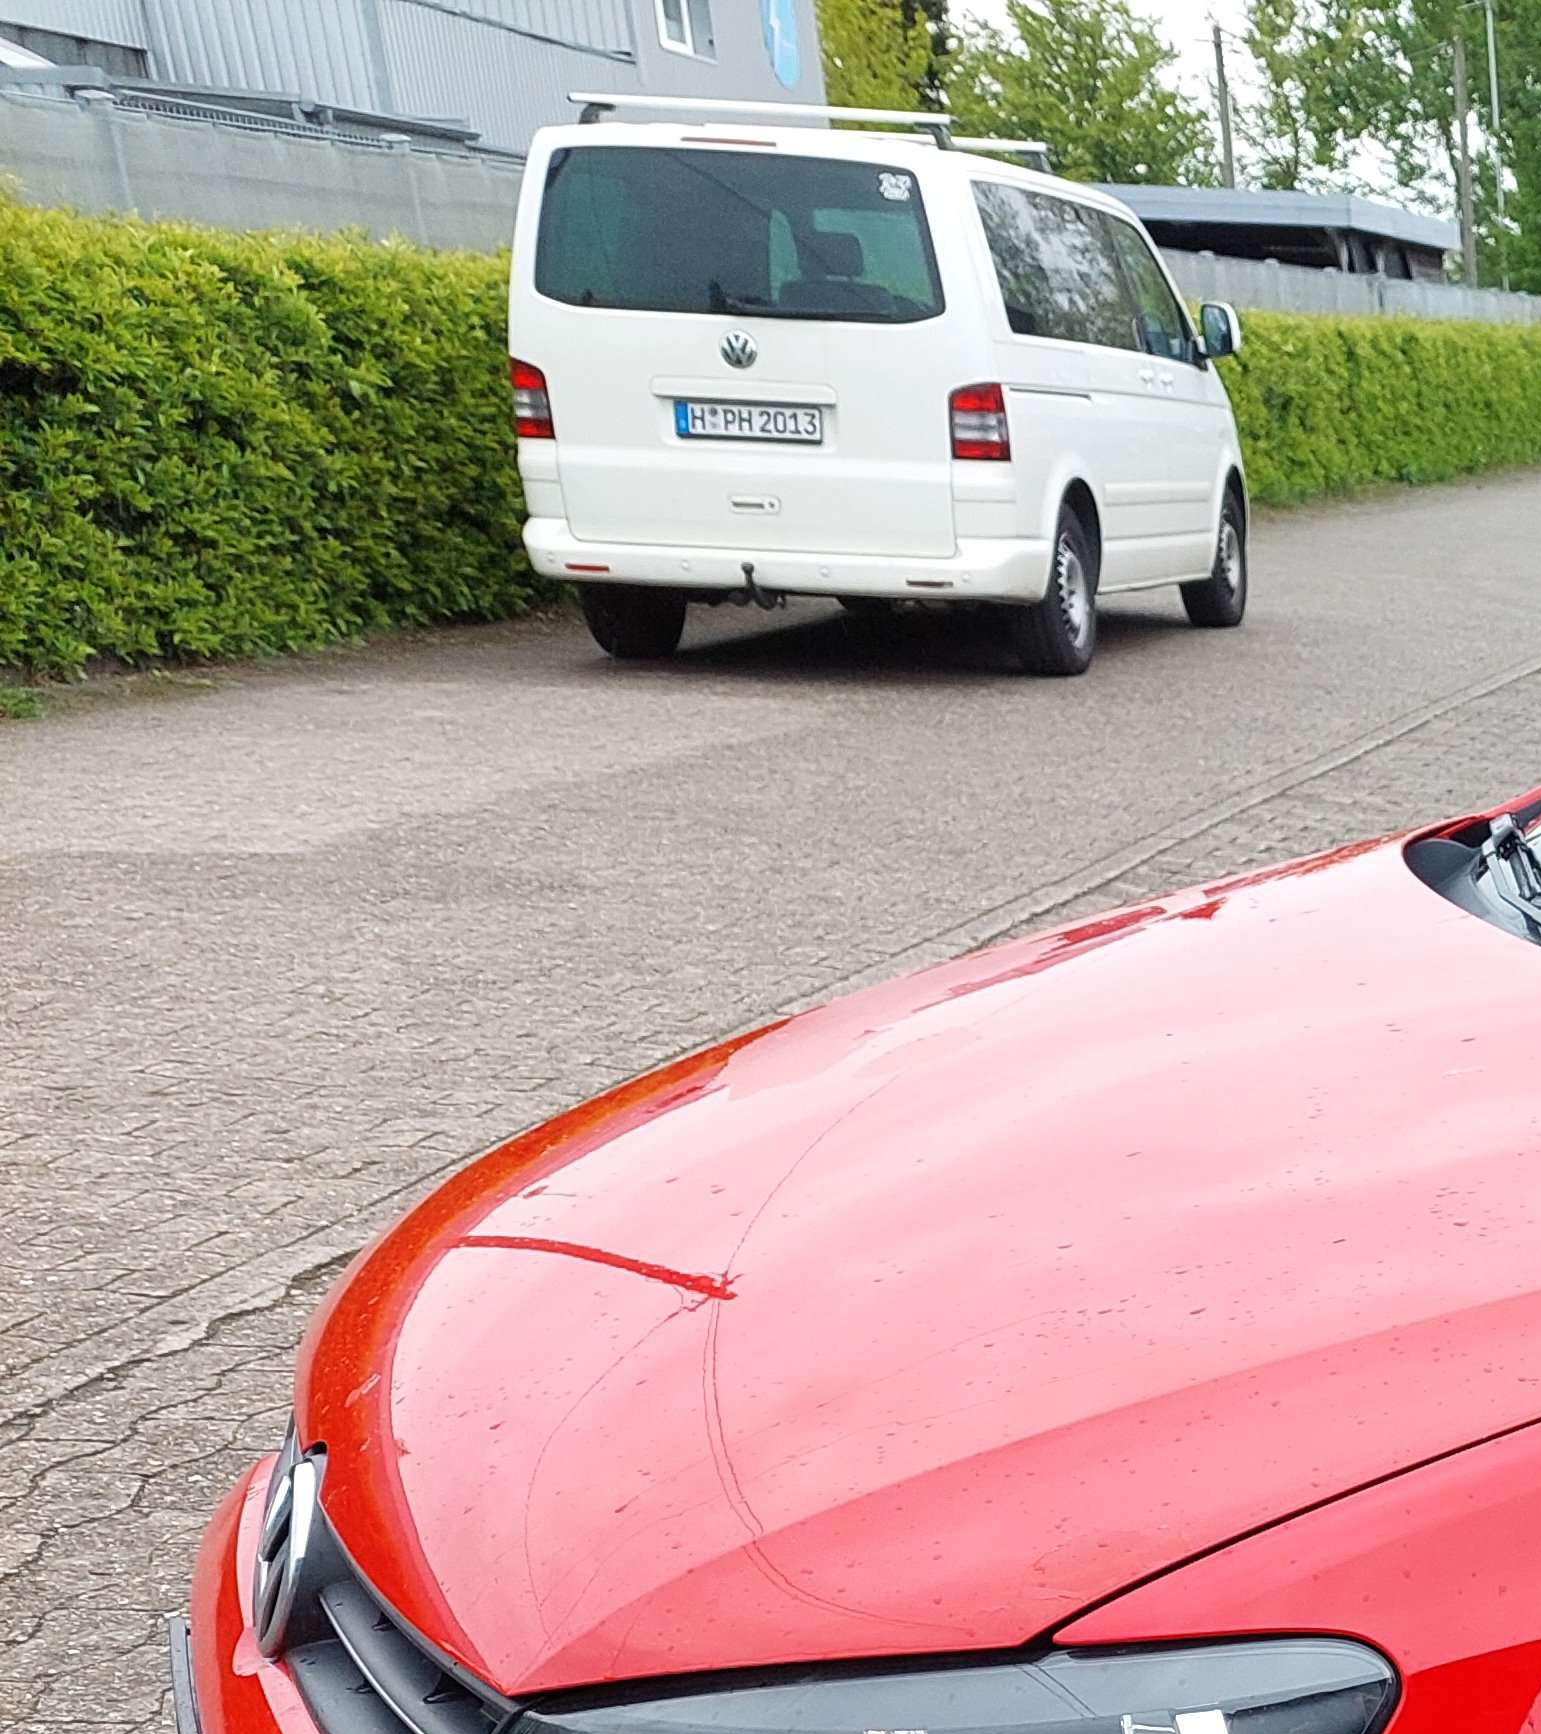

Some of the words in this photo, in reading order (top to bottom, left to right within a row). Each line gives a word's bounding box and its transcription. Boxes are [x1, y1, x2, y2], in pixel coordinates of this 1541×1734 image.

[720, 330, 757, 368] VW
[690, 406, 706, 431] H
[723, 409, 753, 432] PH
[758, 410, 817, 436] 2013
